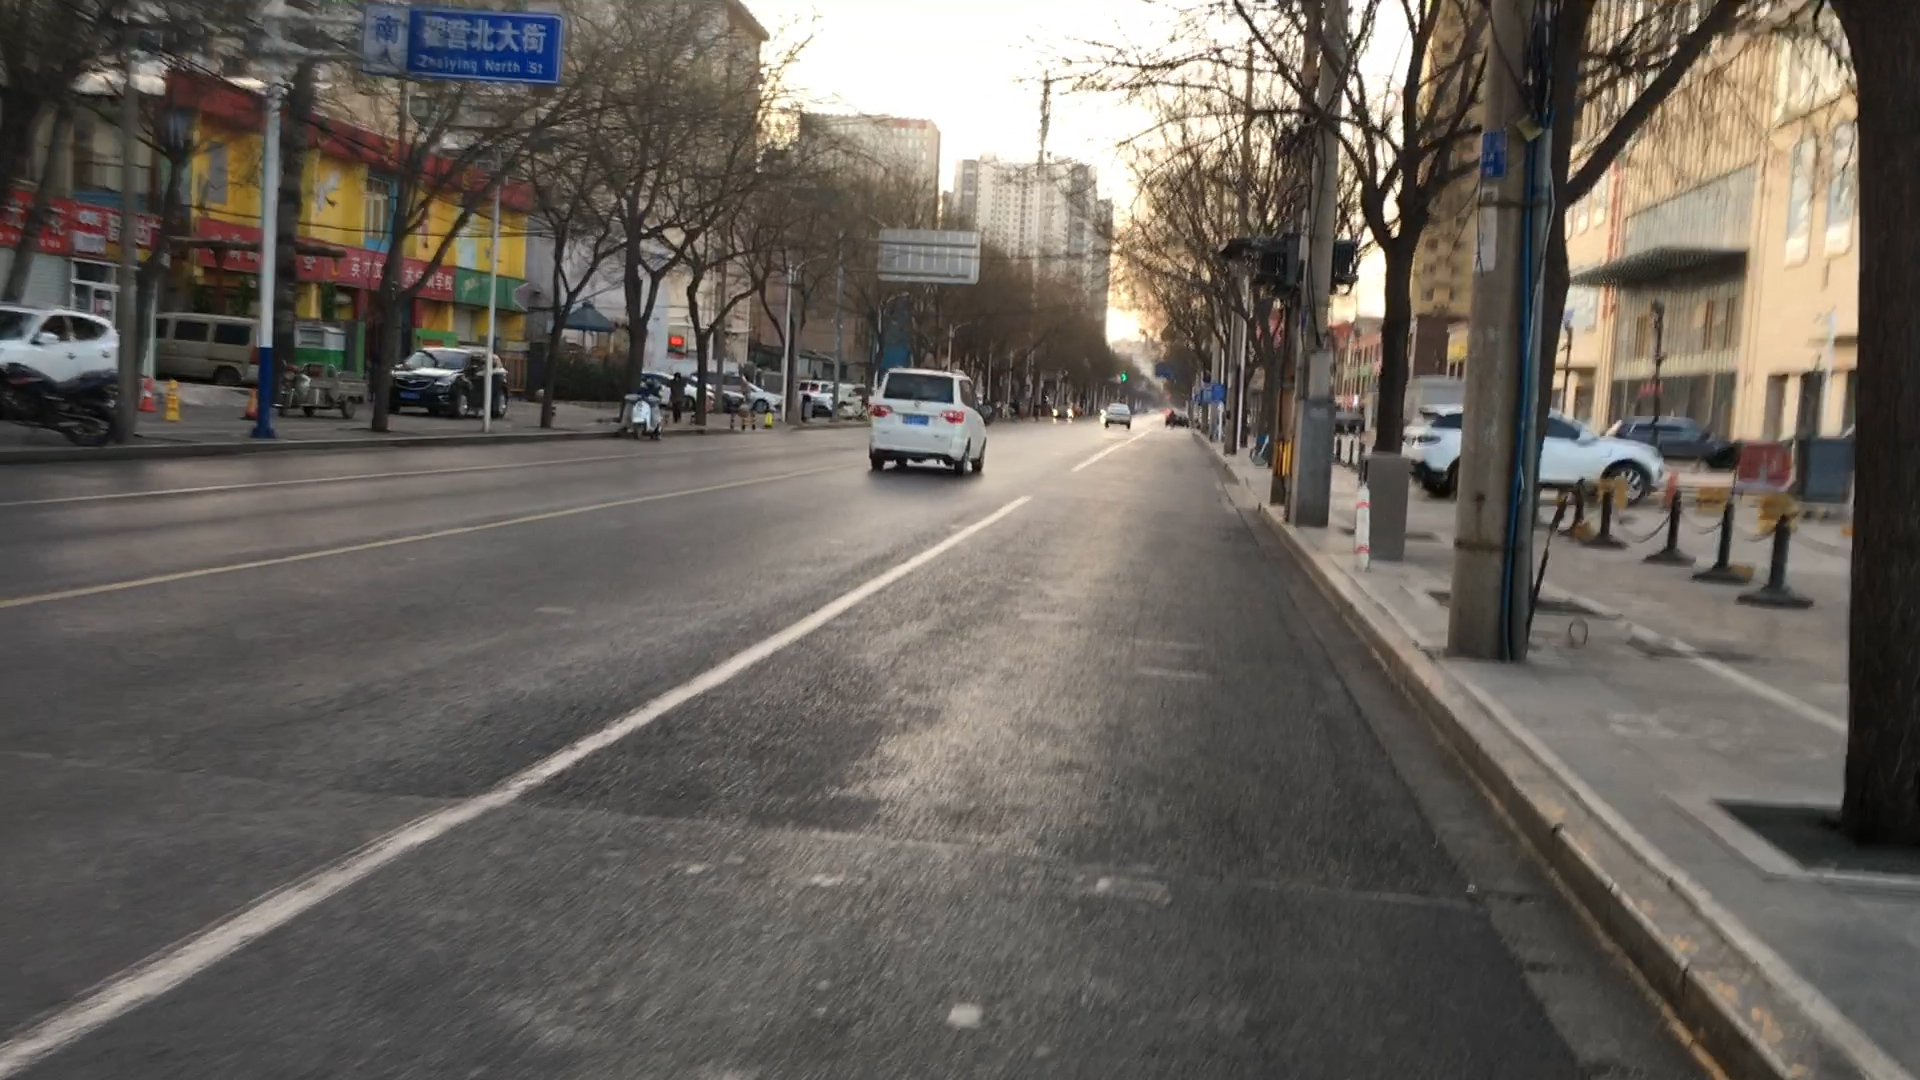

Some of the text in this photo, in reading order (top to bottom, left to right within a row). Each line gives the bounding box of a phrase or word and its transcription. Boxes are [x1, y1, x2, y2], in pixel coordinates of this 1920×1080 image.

[374, 15, 401, 44] 南
[485, 59, 521, 73] North
[527, 60, 544, 75] St
